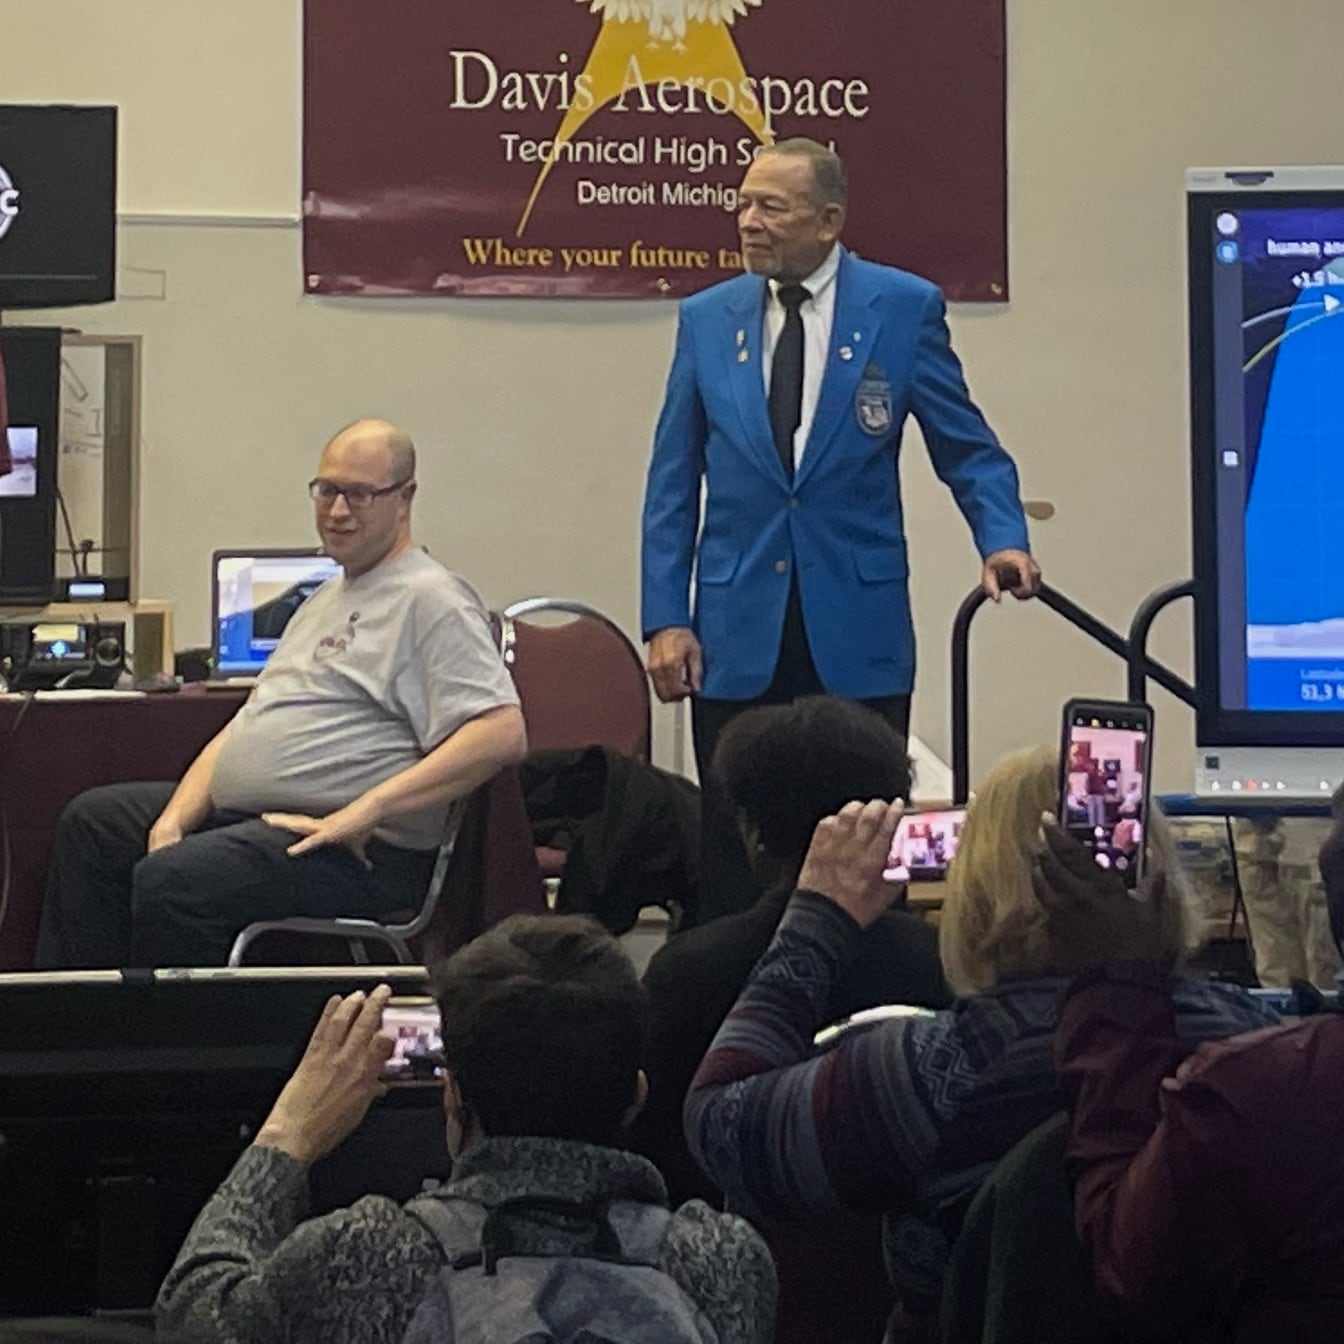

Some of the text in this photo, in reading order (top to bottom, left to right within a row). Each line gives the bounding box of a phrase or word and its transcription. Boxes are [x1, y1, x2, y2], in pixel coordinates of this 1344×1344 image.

[449, 50, 870, 136] Davis Aerospace
[500, 133, 645, 163] Technical
[654, 136, 727, 173] High
[577, 180, 742, 212] Detroit Michig
[463, 237, 553, 267] Where
[561, 247, 622, 272] your
[630, 240, 710, 269] future
